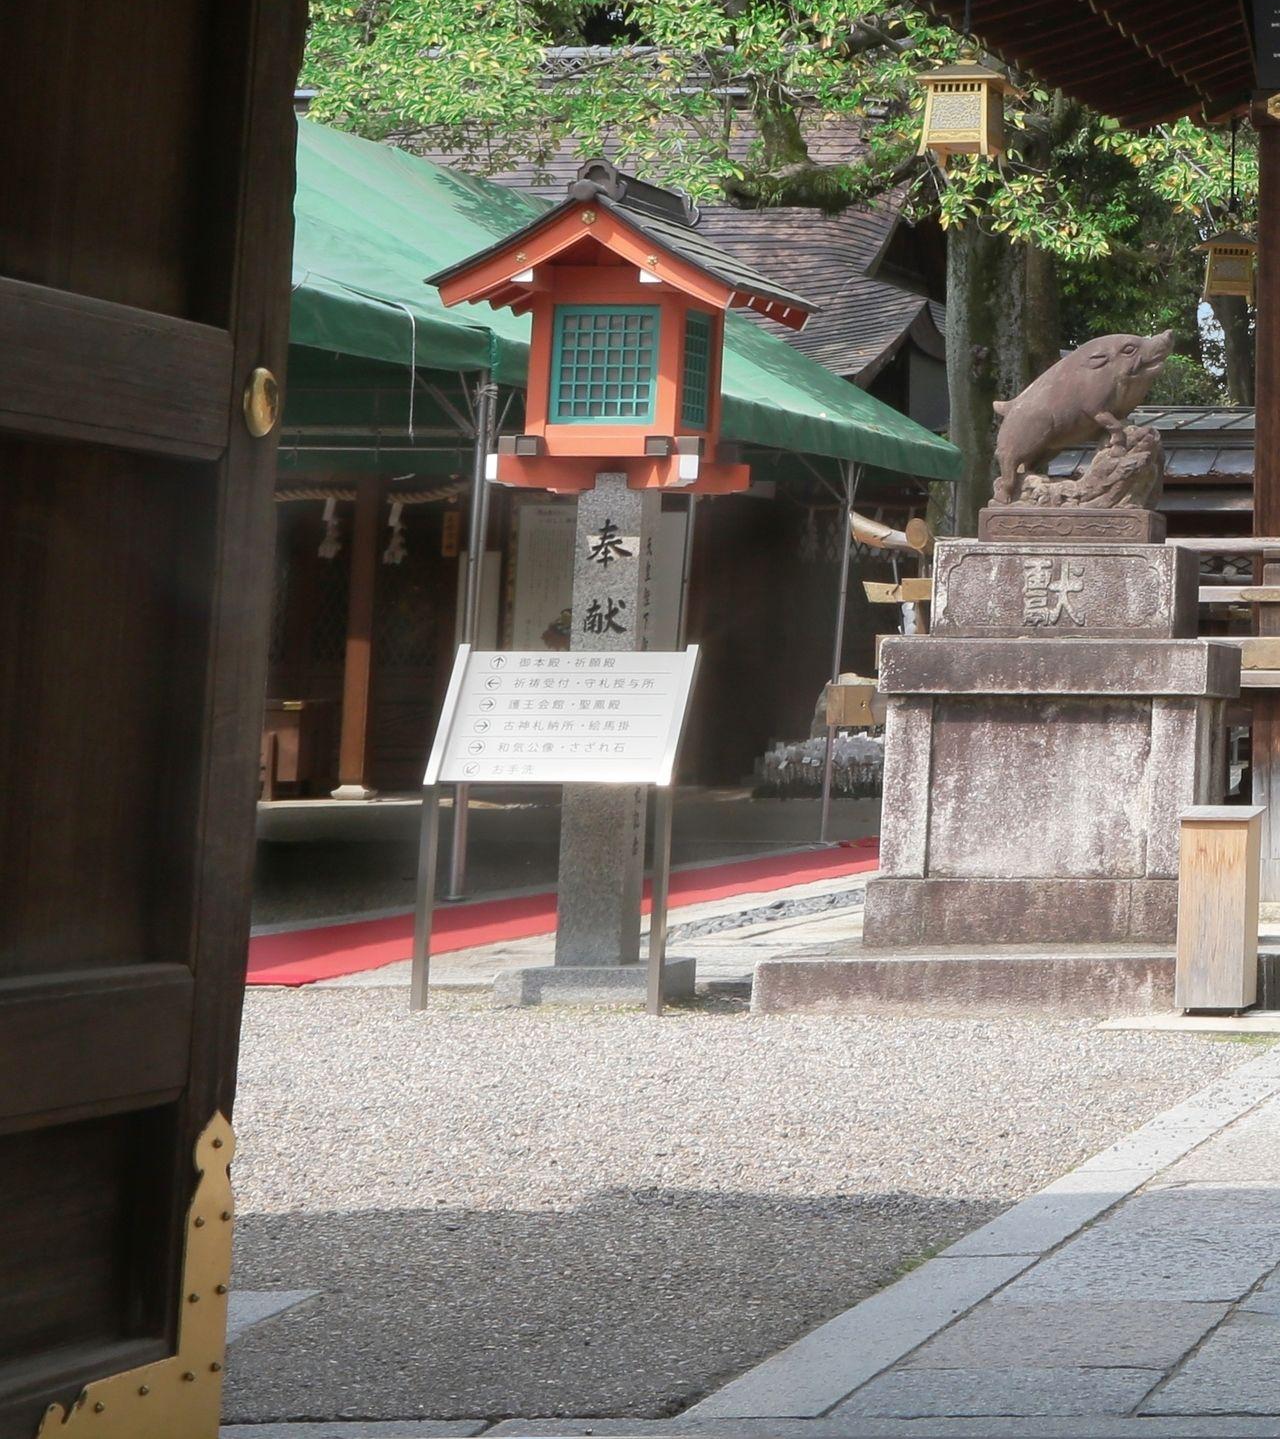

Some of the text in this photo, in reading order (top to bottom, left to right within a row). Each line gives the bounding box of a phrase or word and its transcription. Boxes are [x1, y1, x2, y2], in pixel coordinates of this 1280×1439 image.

[583, 518, 633, 634] 奉献
[519, 656, 616, 668] 御本殿・祈願殿
